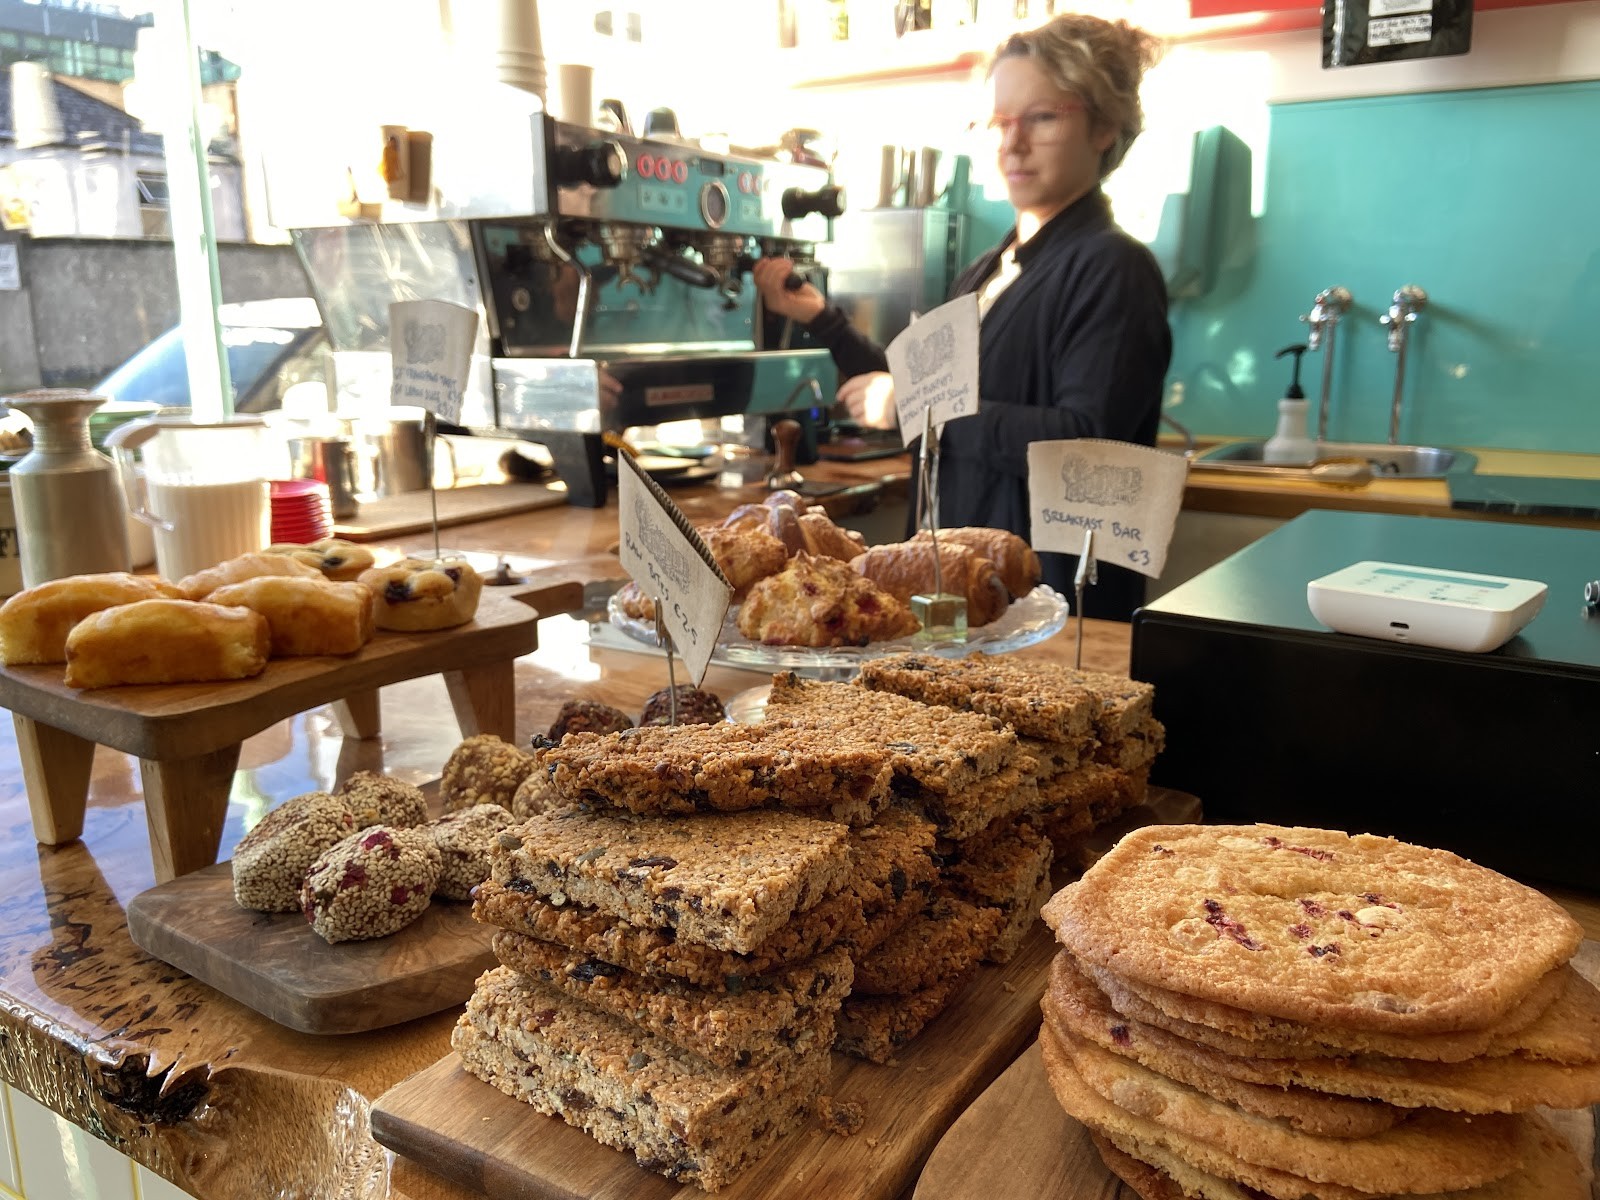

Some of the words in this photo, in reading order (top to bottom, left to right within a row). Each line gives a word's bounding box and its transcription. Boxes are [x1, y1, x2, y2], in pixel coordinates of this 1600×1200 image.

[1042, 508, 1104, 530] BREAKFAST
[1112, 521, 1142, 541] BAR
[1127, 550, 1150, 566] €3
